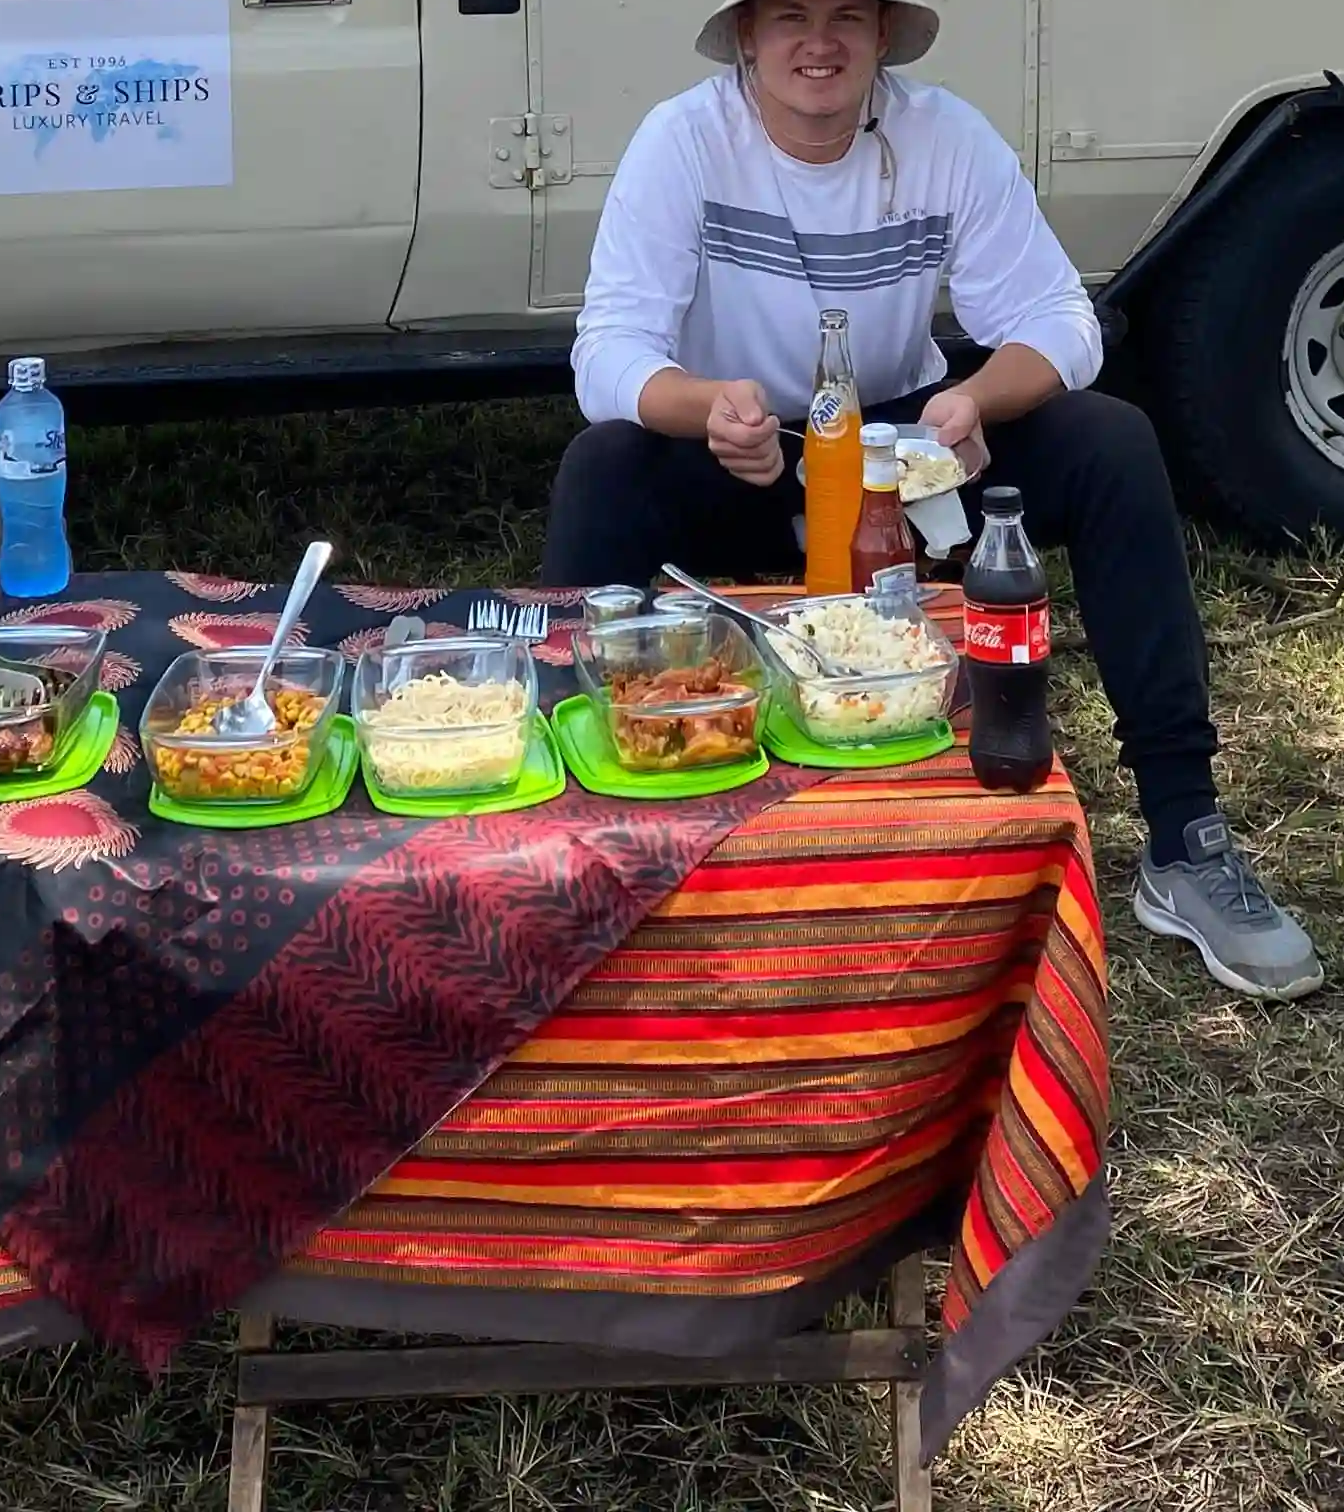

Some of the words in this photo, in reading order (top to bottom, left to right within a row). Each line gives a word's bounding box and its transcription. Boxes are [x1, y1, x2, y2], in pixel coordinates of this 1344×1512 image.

[47, 57, 81, 69] EST
[75, 84, 99, 105] &
[114, 77, 210, 104] SHIPS
[12, 113, 88, 130] LUXURY
[96, 110, 165, 127] TRAVEL
